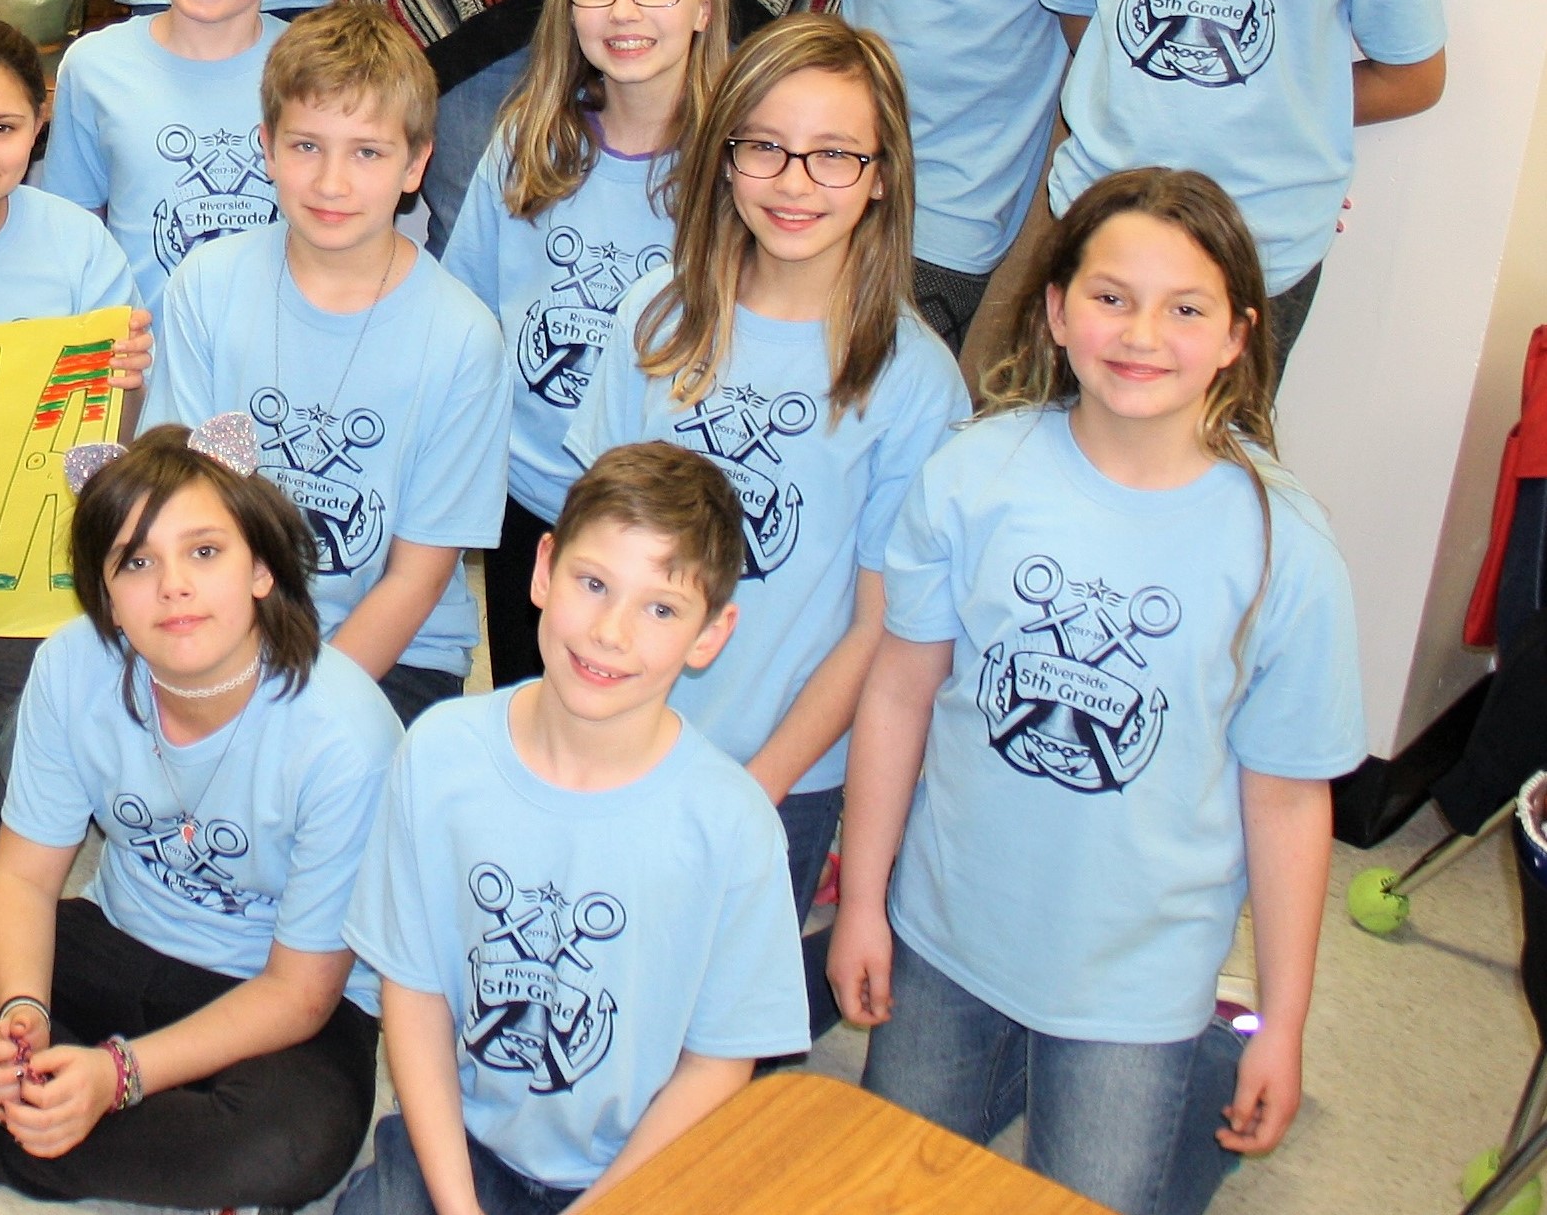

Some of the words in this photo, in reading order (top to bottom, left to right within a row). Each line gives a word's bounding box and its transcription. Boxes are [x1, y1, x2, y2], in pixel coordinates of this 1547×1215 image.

[199, 200, 252, 211] Riverside
[184, 213, 212, 227] 5th
[217, 211, 268, 226] Grade
[551, 321, 581, 338] 5th
[276, 471, 334, 495] Riverside
[292, 489, 351, 511] Grade
[1039, 661, 1109, 691] Riverside
[1018, 668, 1052, 695] 5th
[1057, 683, 1126, 716] Grade
[527, 929, 550, 937] 2017
[504, 968, 554, 983] Rivers
[481, 978, 520, 996] 5th
[527, 985, 574, 1021] Grde
